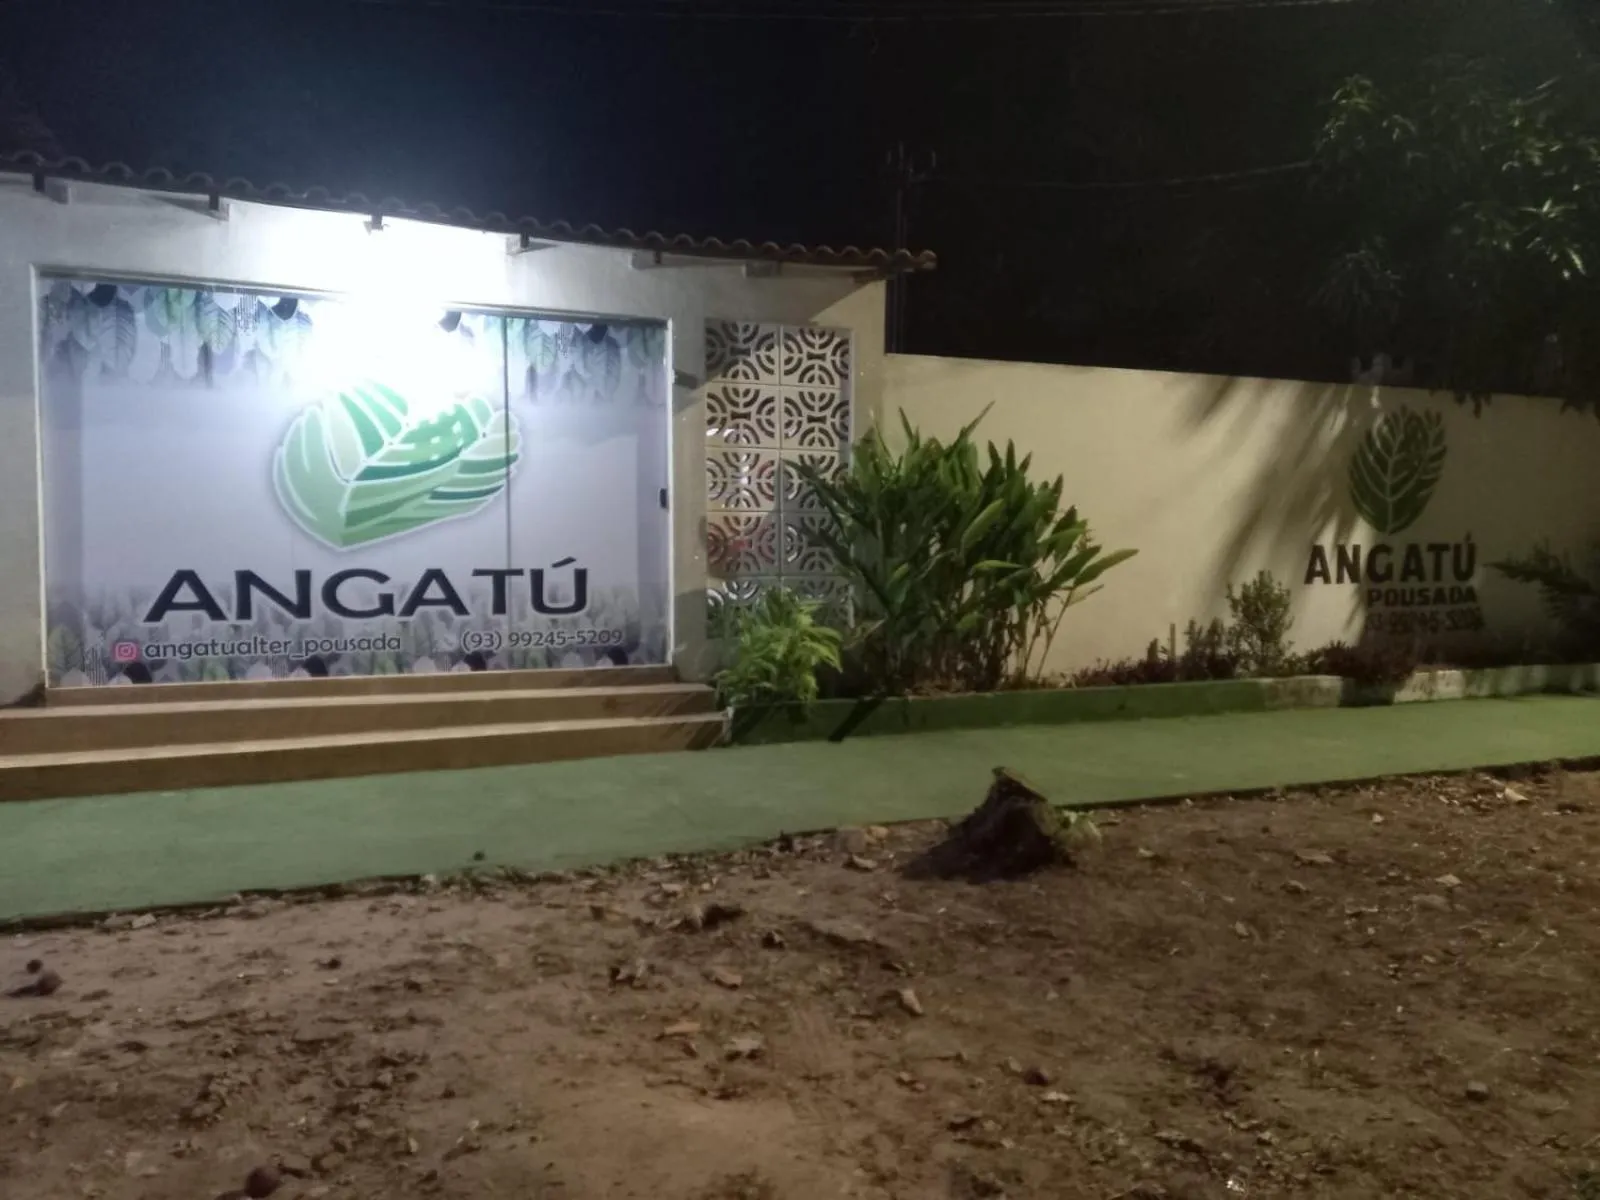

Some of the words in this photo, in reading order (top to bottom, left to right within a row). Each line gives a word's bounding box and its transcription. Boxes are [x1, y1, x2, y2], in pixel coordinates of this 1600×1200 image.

[1304, 531, 1477, 585] ANGATÚ
[143, 556, 588, 623] ANGATÚ
[1366, 586, 1478, 608] POUSADA
[144, 632, 401, 659] angatualter_pousada
[462, 631, 502, 652] (93)
[509, 629, 623, 648] 99245-5209
